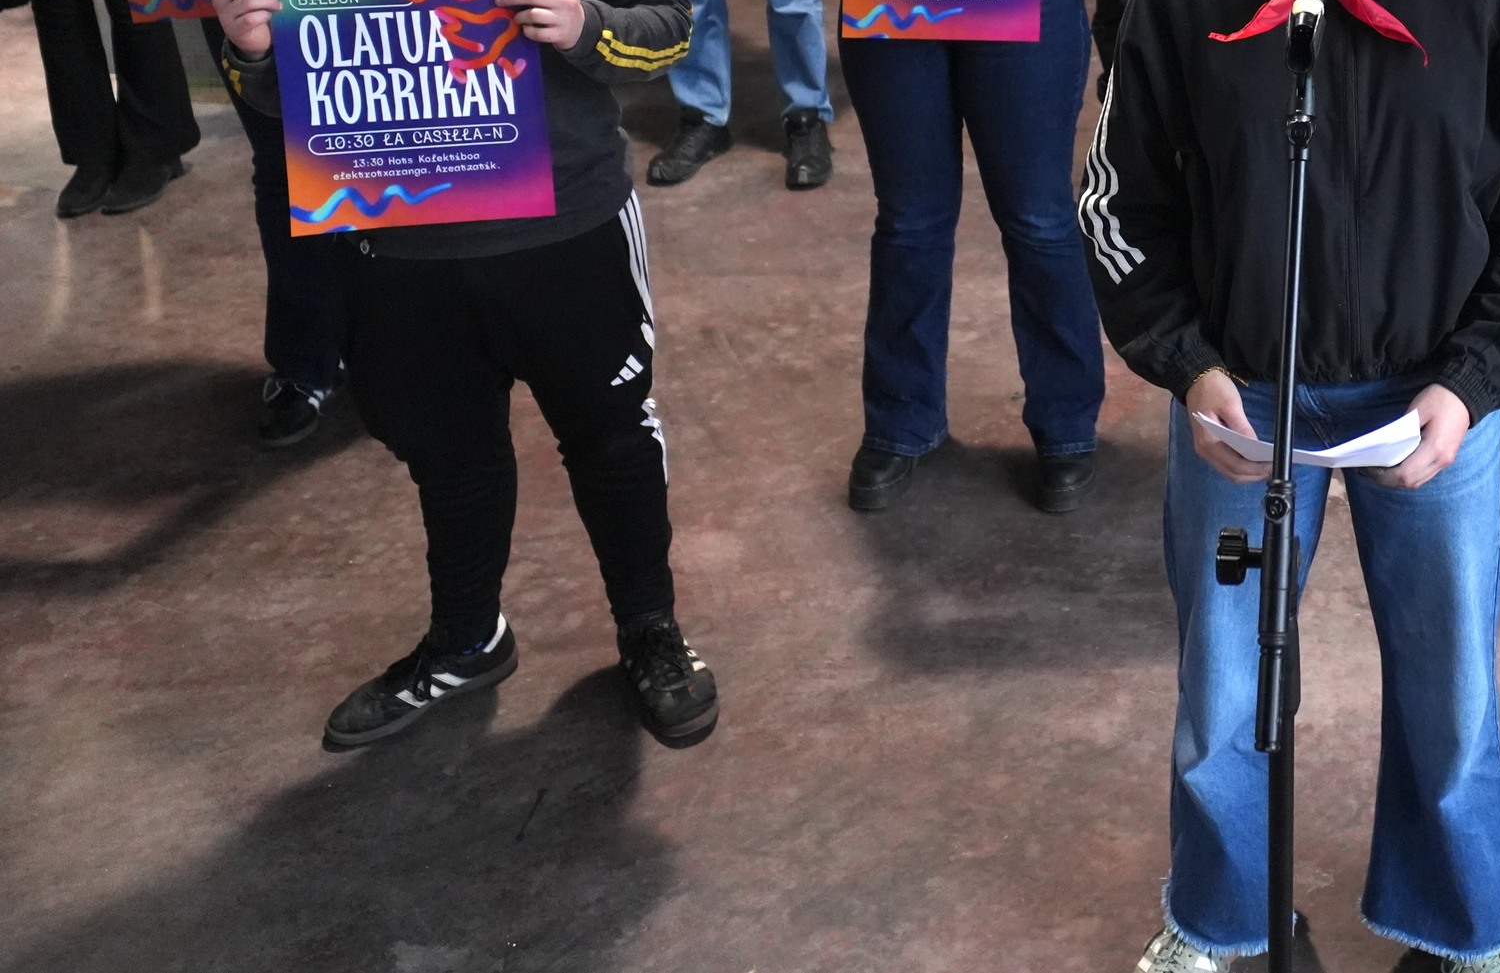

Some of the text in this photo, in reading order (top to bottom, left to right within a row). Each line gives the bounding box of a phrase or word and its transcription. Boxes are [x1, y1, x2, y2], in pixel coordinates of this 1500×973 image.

[299, 10, 453, 69] OLATUA
[306, 63, 516, 126] KORRIKAN
[324, 134, 375, 150] 10:30
[383, 132, 405, 146] LA
[352, 157, 384, 168] 13:30
[388, 156, 413, 166] Hots
